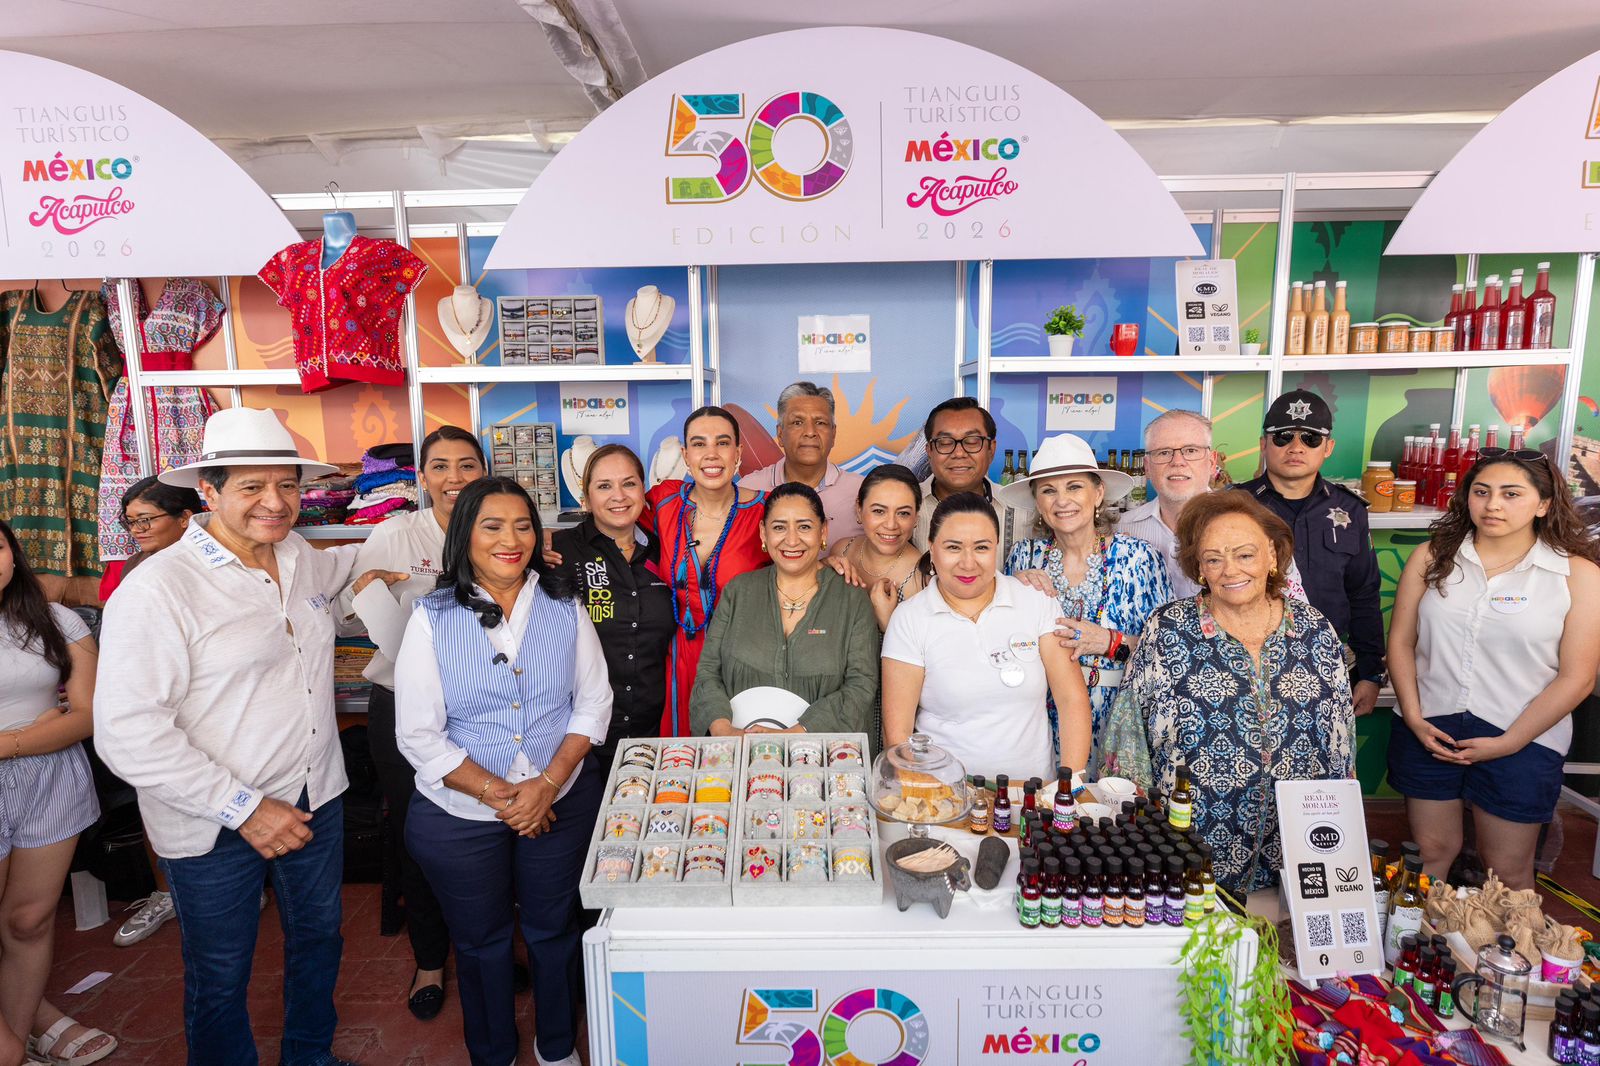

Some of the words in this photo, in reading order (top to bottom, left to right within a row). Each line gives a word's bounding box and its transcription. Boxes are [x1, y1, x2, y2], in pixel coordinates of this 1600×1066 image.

[904, 84, 1021, 104] TIANGUIS
[14, 104, 127, 123] TIANGUIS
[904, 105, 1021, 123] TURÍSTICO
[16, 124, 129, 144] TURÍSTICO
[665, 90, 854, 205] 50
[906, 166, 1019, 217] Acapulco
[28, 186, 135, 235] Acapulco
[671, 222, 852, 246] EDICIÓN
[916, 219, 1011, 240] 2026
[41, 238, 133, 258] 2026
[1312, 833, 1339, 842] KMD
[1335, 884, 1364, 892] VEGANO
[982, 984, 1103, 1000] TIANGUIS
[982, 1001, 1103, 1019] TURÍSTICO
